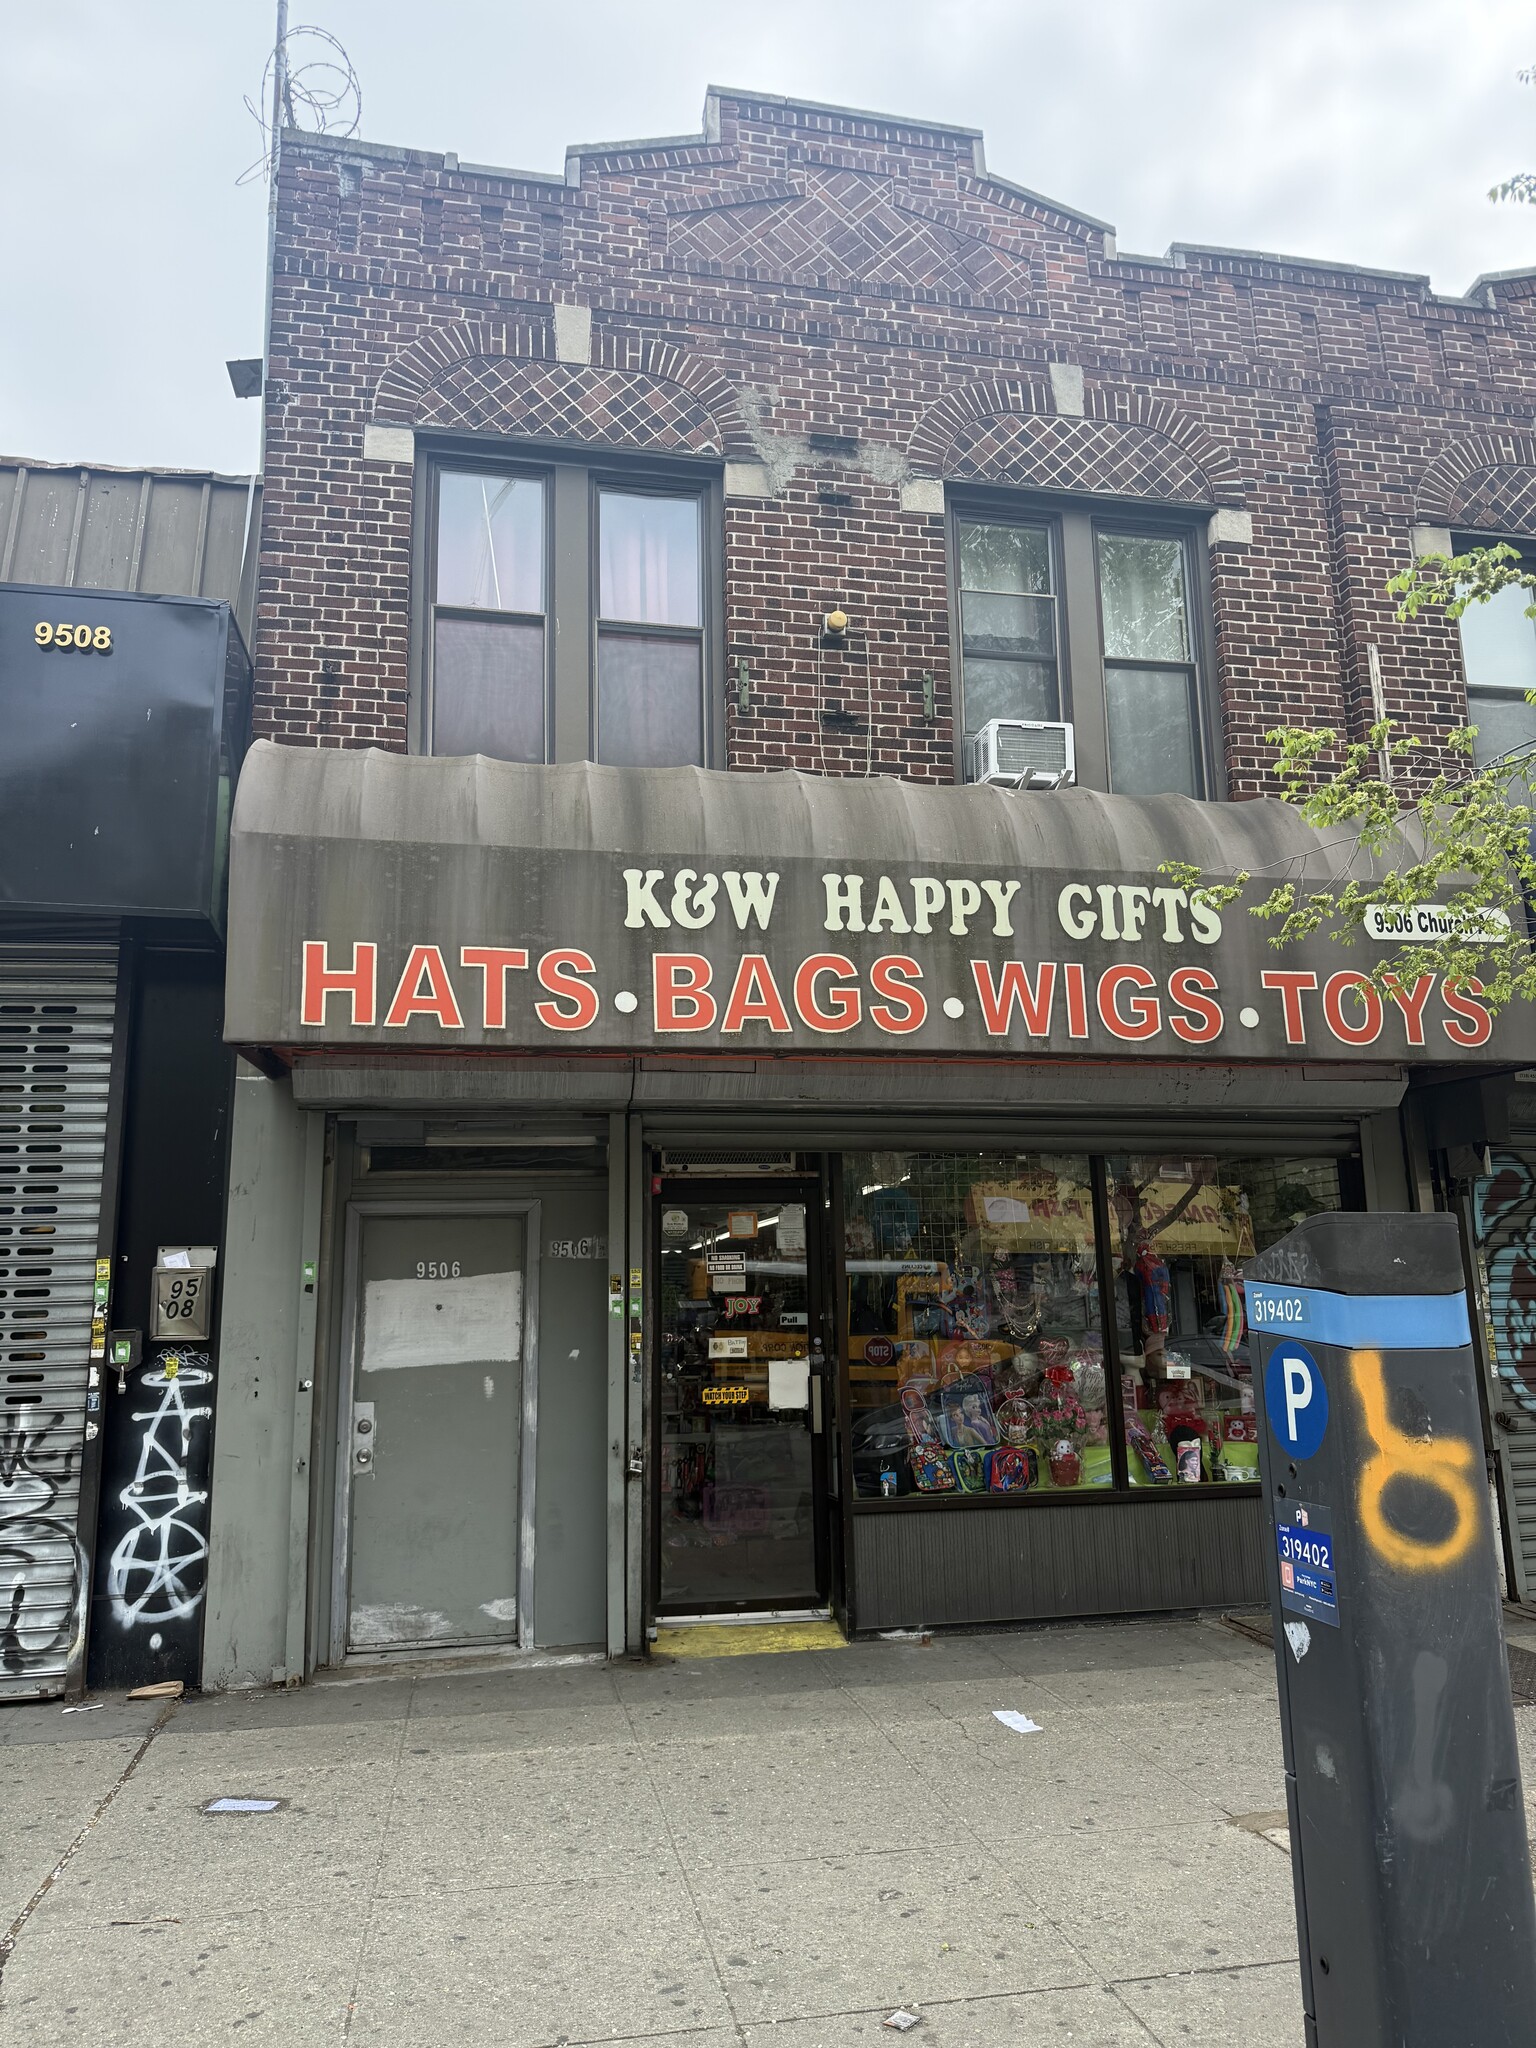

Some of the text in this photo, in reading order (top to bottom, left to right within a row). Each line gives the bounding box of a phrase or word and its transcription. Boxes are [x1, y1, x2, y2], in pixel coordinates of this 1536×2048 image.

[34, 621, 112, 650] 9508
[623, 868, 1222, 944] K&W HAPPY GIFTS
[300, 940, 1493, 1048] HATS BAGS WIGS TOYS
[416, 1261, 461, 1278] 9506
[171, 1278, 199, 1299] 95
[166, 1299, 194, 1319] 08
[725, 1297, 761, 1317] JOY
[1255, 1299, 1303, 1322] 319402
[704, 1390, 748, 1401] WATCH YOUR STEP
[1282, 1358, 1313, 1442] P
[1281, 1535, 1330, 1569] 319402
